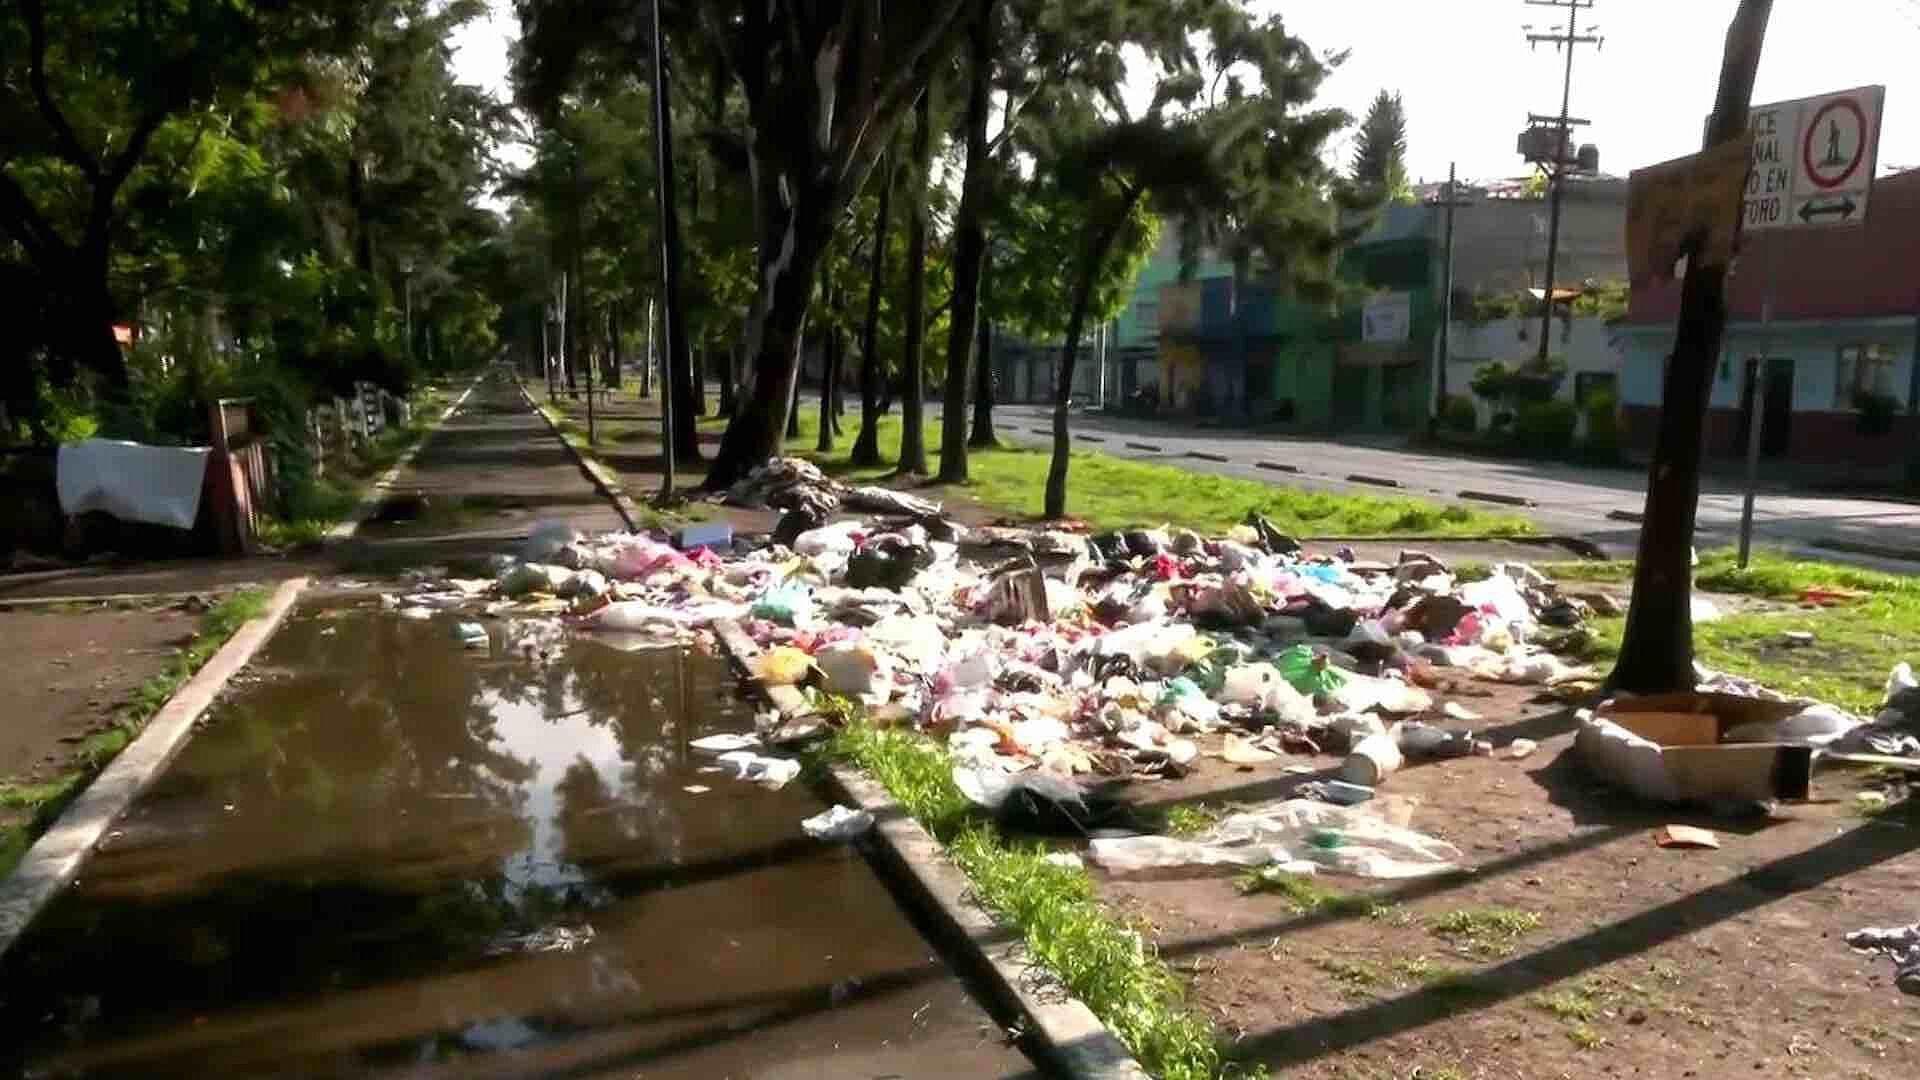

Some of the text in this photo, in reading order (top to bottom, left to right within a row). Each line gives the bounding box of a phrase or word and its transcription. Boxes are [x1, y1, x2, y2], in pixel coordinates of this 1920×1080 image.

[1752, 109, 1778, 137] CE
[1752, 138, 1781, 163] NAL
[1766, 167, 1788, 193] EN
[1743, 198, 1780, 225] FORO
